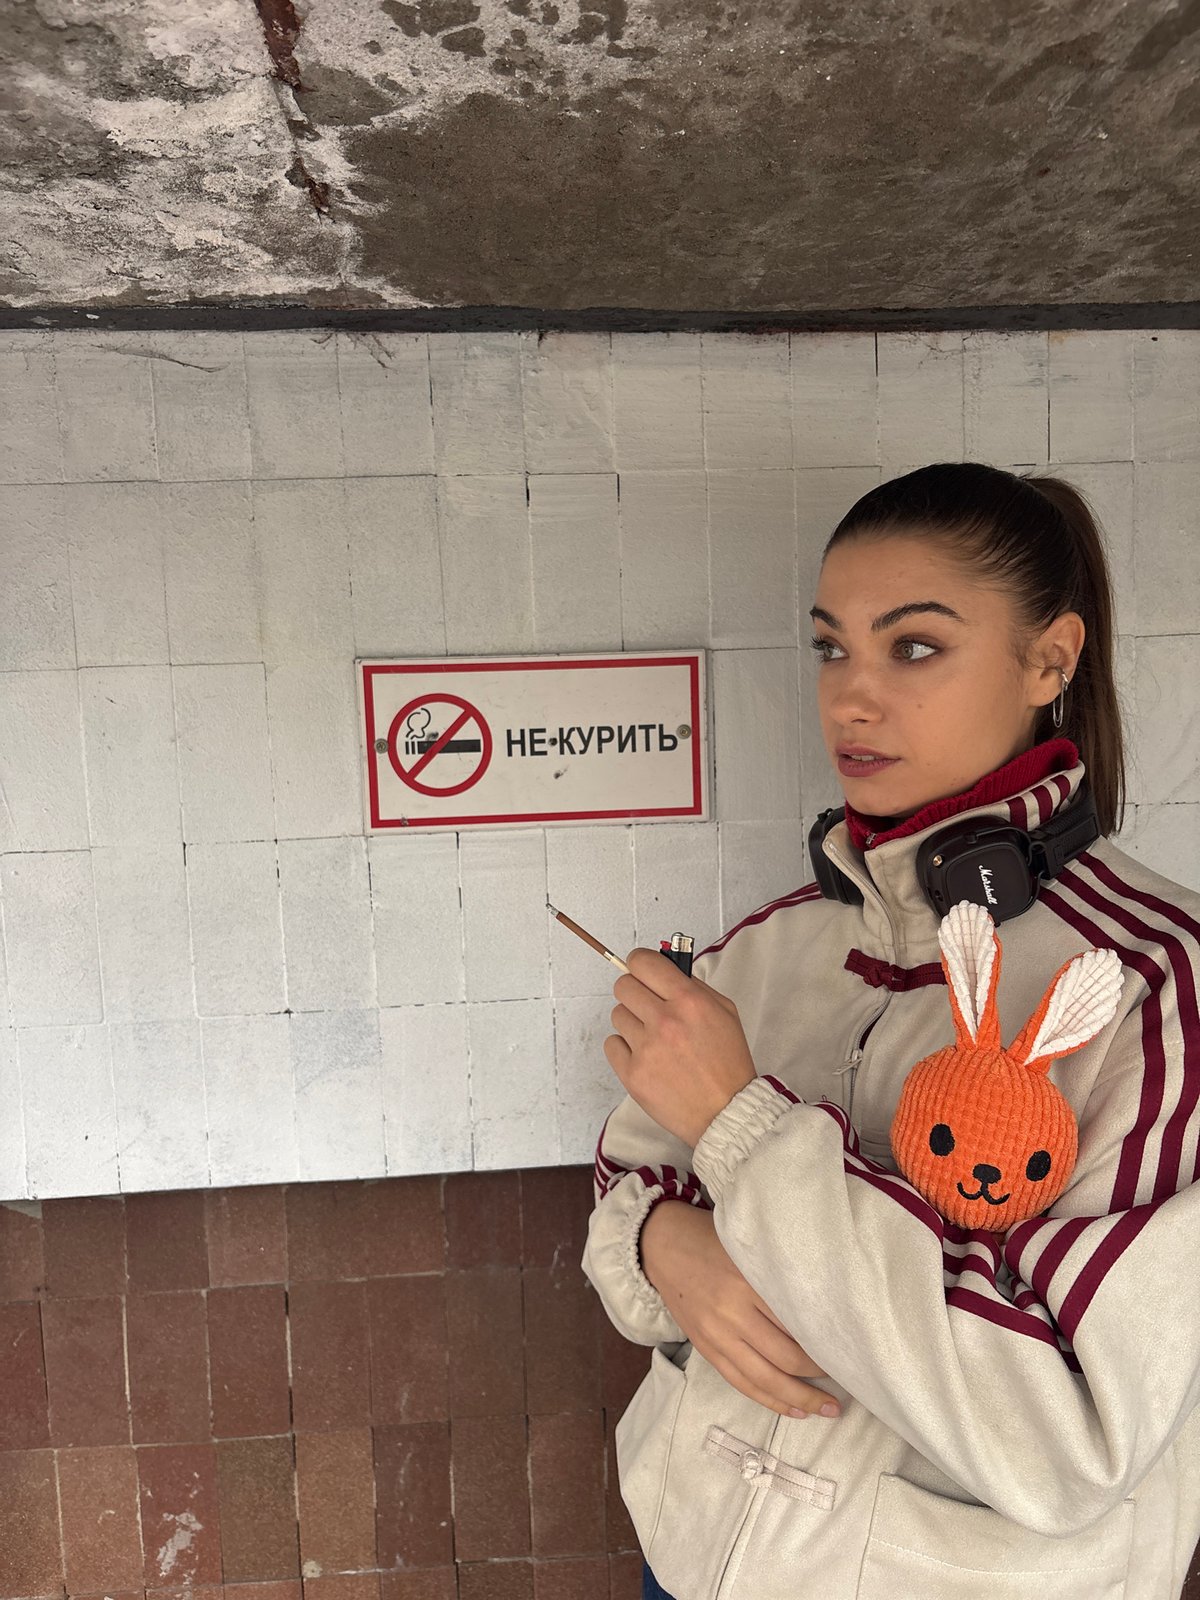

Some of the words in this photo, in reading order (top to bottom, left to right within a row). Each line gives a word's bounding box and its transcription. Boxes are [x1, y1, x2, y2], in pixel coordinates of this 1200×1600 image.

[506, 728, 548, 757] НЕ
[558, 724, 678, 755] КУРИТЬ
[978, 865, 998, 905] Marshall
